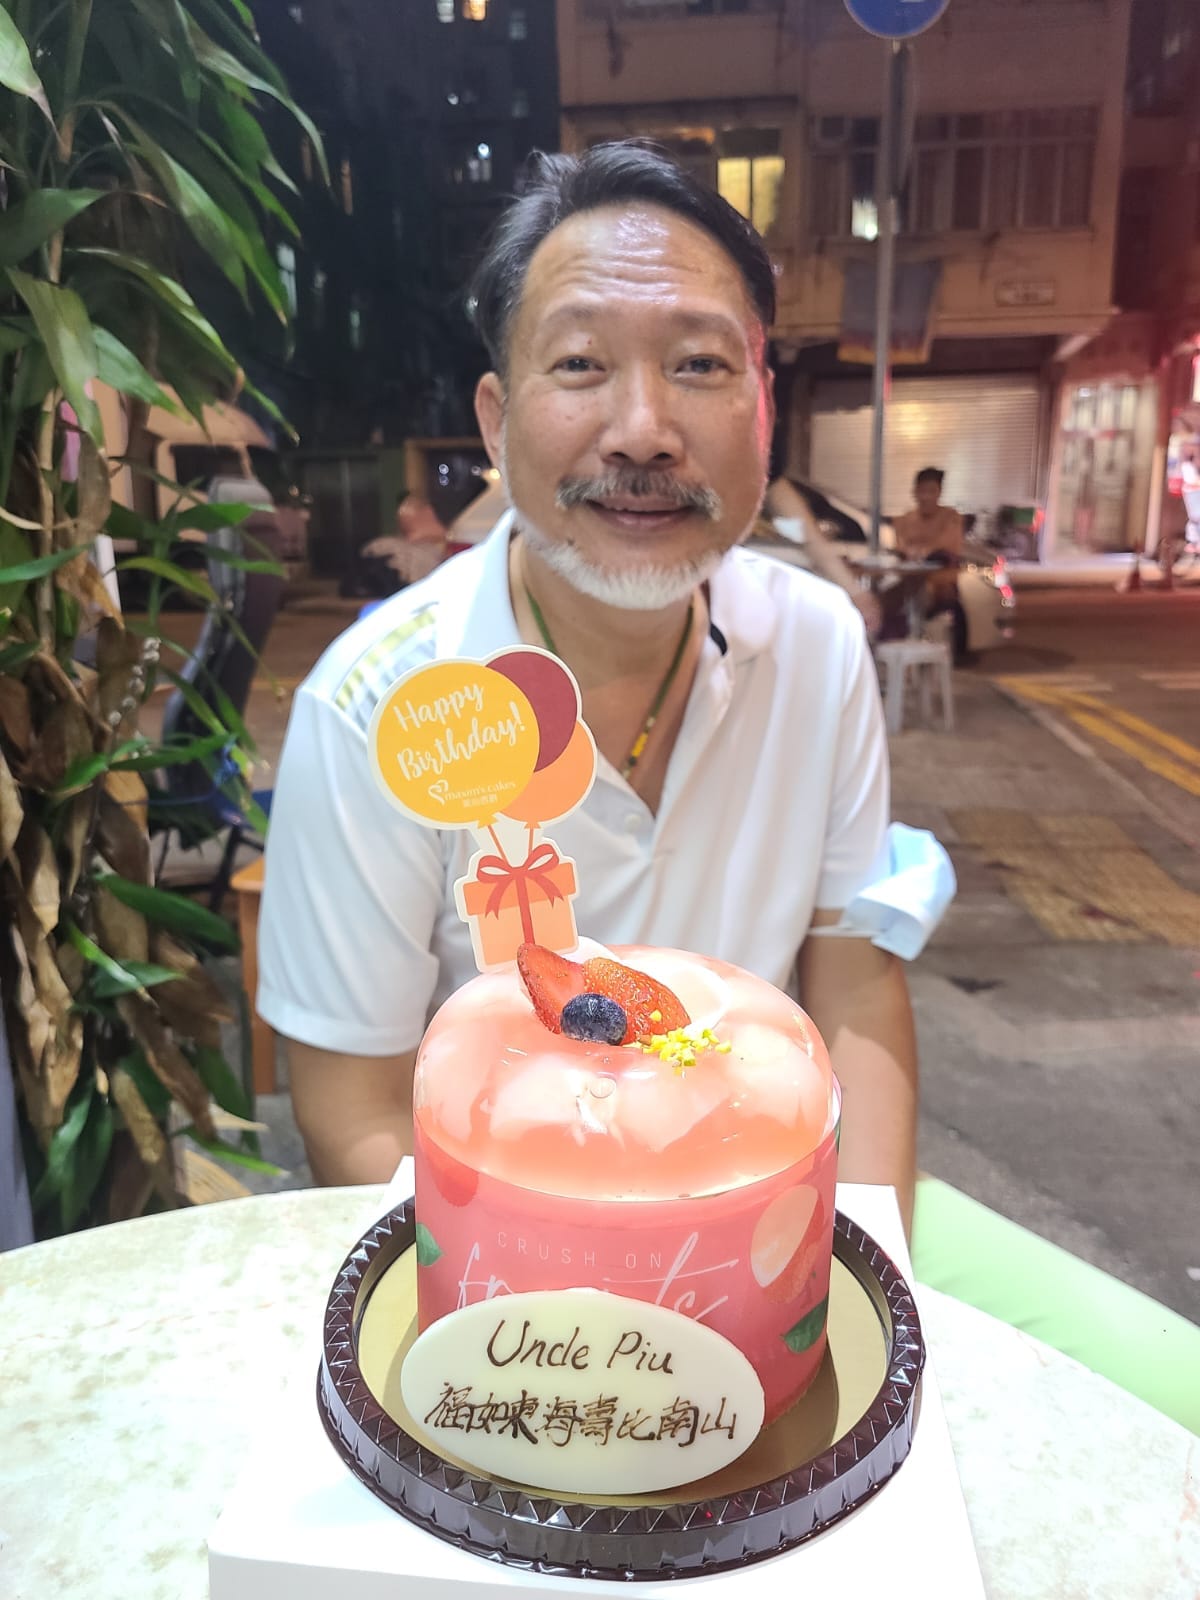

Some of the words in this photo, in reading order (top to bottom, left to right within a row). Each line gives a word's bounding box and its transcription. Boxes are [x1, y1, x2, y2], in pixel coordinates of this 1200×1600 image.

[393, 683, 484, 732] Happy
[396, 701, 526, 781] Birthday!
[497, 1231, 596, 1268] CRUSH
[624, 1252, 662, 1269] ON
[486, 1319, 590, 1371] Uncle
[606, 1330, 674, 1375] Piu
[423, 1381, 737, 1447] 福如東海壽比南山
